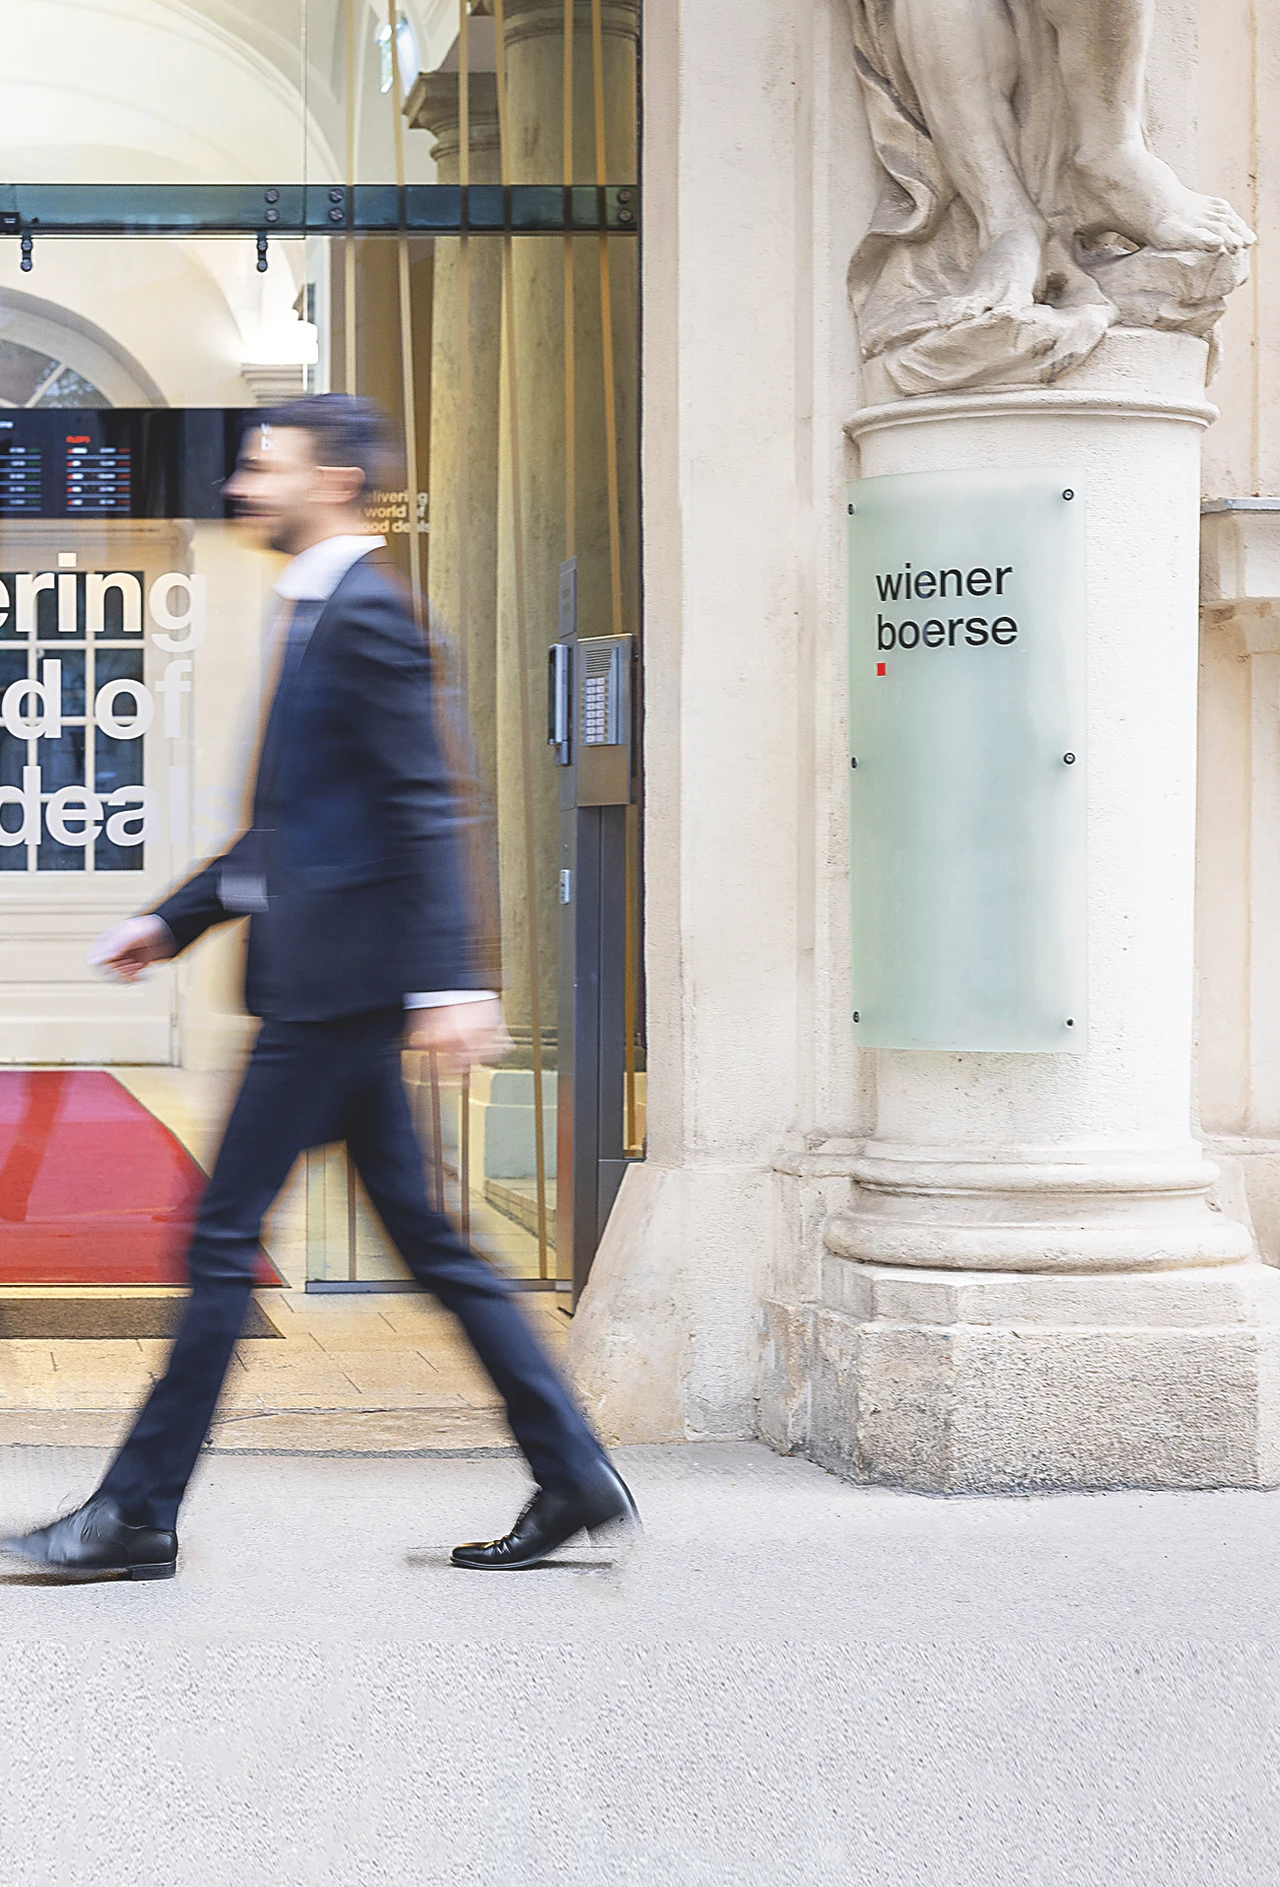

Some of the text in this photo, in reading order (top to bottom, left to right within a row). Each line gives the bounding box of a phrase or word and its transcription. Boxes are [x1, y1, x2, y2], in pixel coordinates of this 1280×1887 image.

[875, 562, 1013, 602] wiener
[877, 613, 1018, 651] boerse
[94, 658, 193, 741] of
